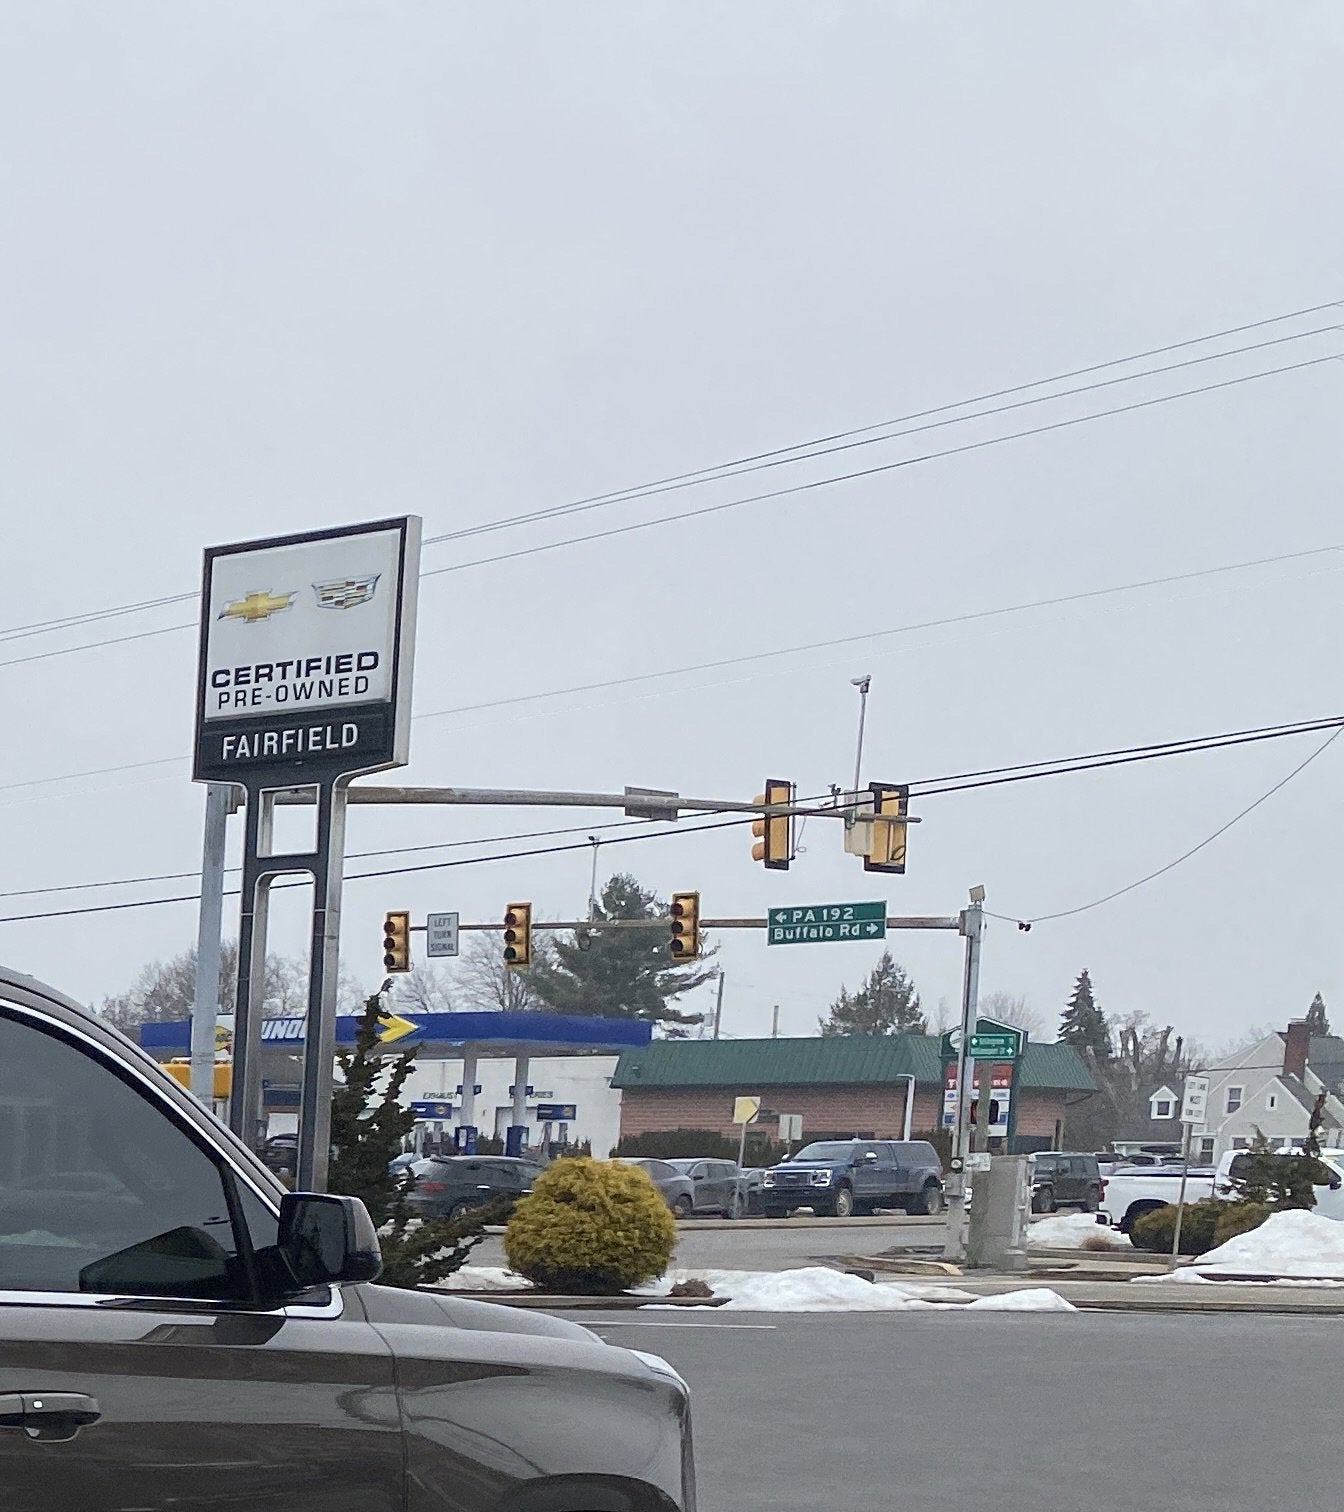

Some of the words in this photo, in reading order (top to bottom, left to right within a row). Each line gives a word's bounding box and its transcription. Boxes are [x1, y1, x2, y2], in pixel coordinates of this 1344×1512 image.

[211, 651, 379, 689] CERTIFIED
[218, 676, 369, 710] PRE-OWNED
[222, 723, 359, 760] FAIRFIELD
[433, 917, 452, 928] LEFT
[792, 909, 816, 923] PA
[822, 907, 854, 921] 192
[774, 925, 833, 940] Buffalo
[840, 924, 860, 936] Rd
[261, 1018, 306, 1040] UNO
